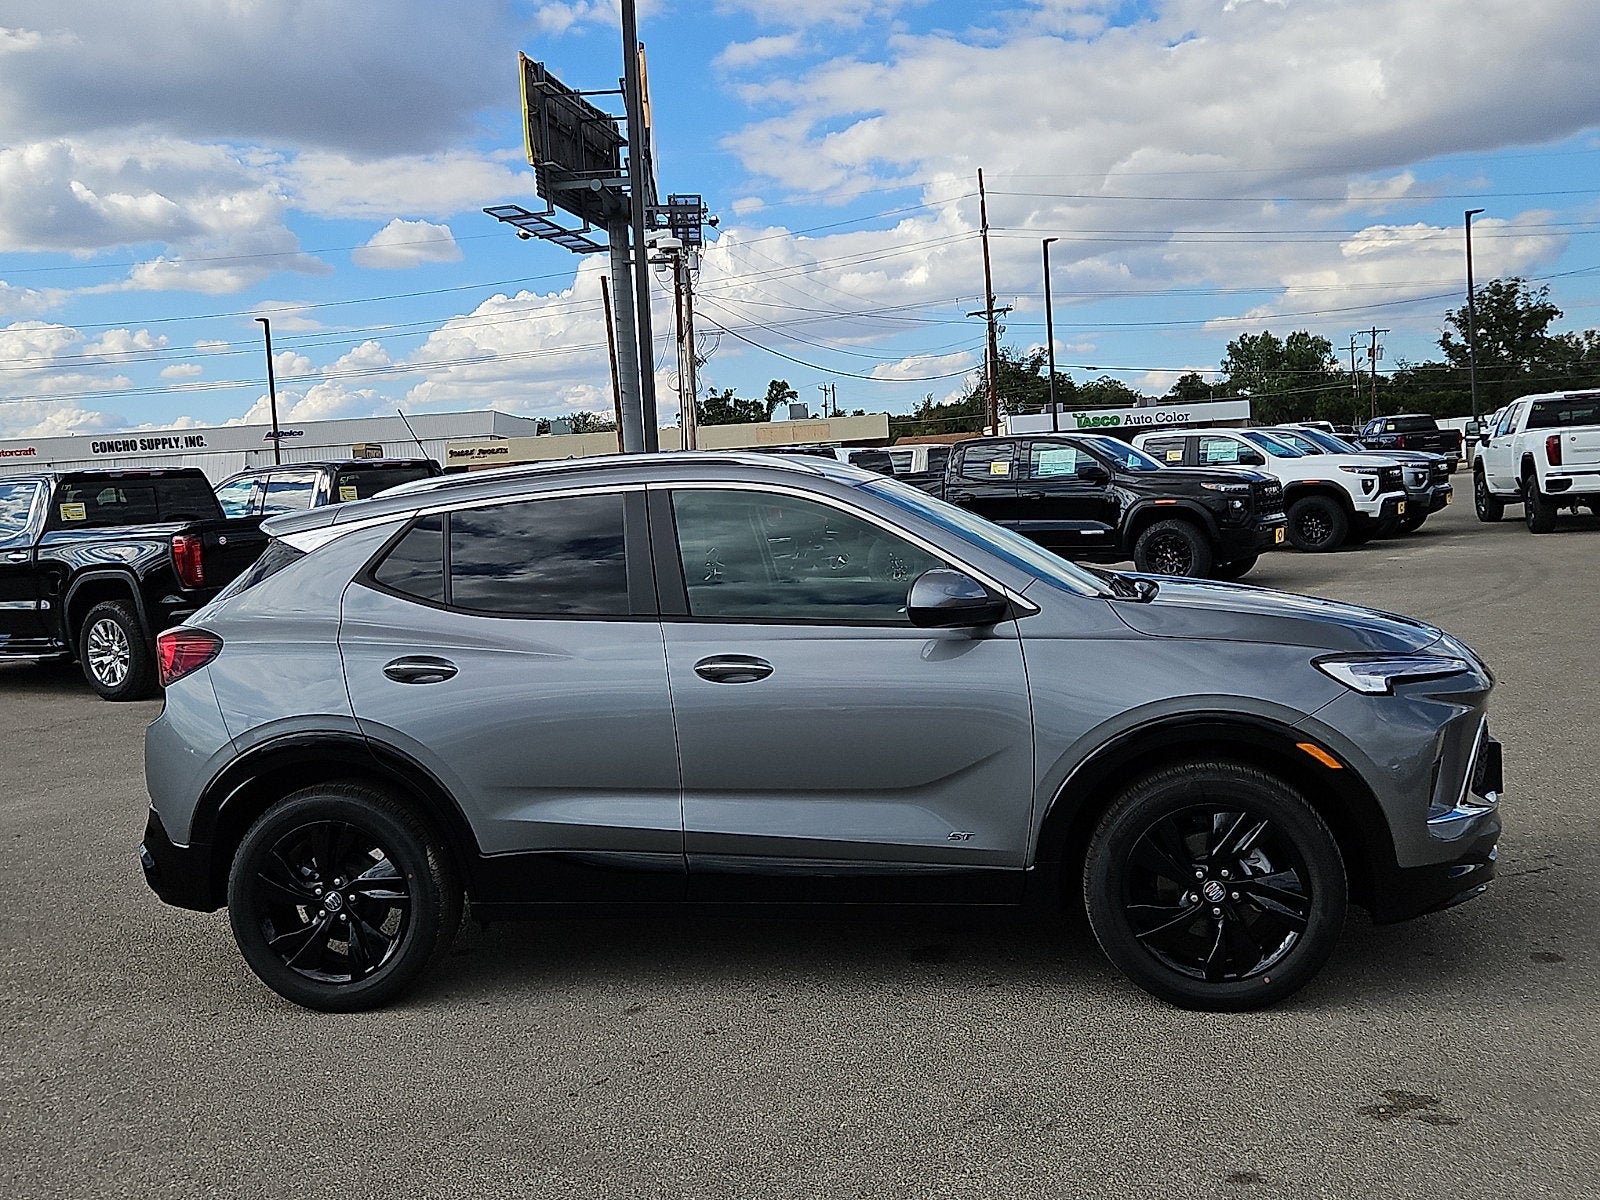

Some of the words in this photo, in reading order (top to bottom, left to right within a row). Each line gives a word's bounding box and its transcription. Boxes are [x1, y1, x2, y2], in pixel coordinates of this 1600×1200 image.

[1072, 412, 1120, 428] TASCO
[1124, 414, 1152, 426] Auto
[1155, 411, 1191, 423] Color
[265, 430, 304, 438] ADelco
[91, 440, 138, 454] CONCHO
[139, 437, 182, 451] SUPPLY,
[184, 435, 208, 448] INC.
[0, 447, 37, 457] torcraft
[947, 831, 975, 841] ST
